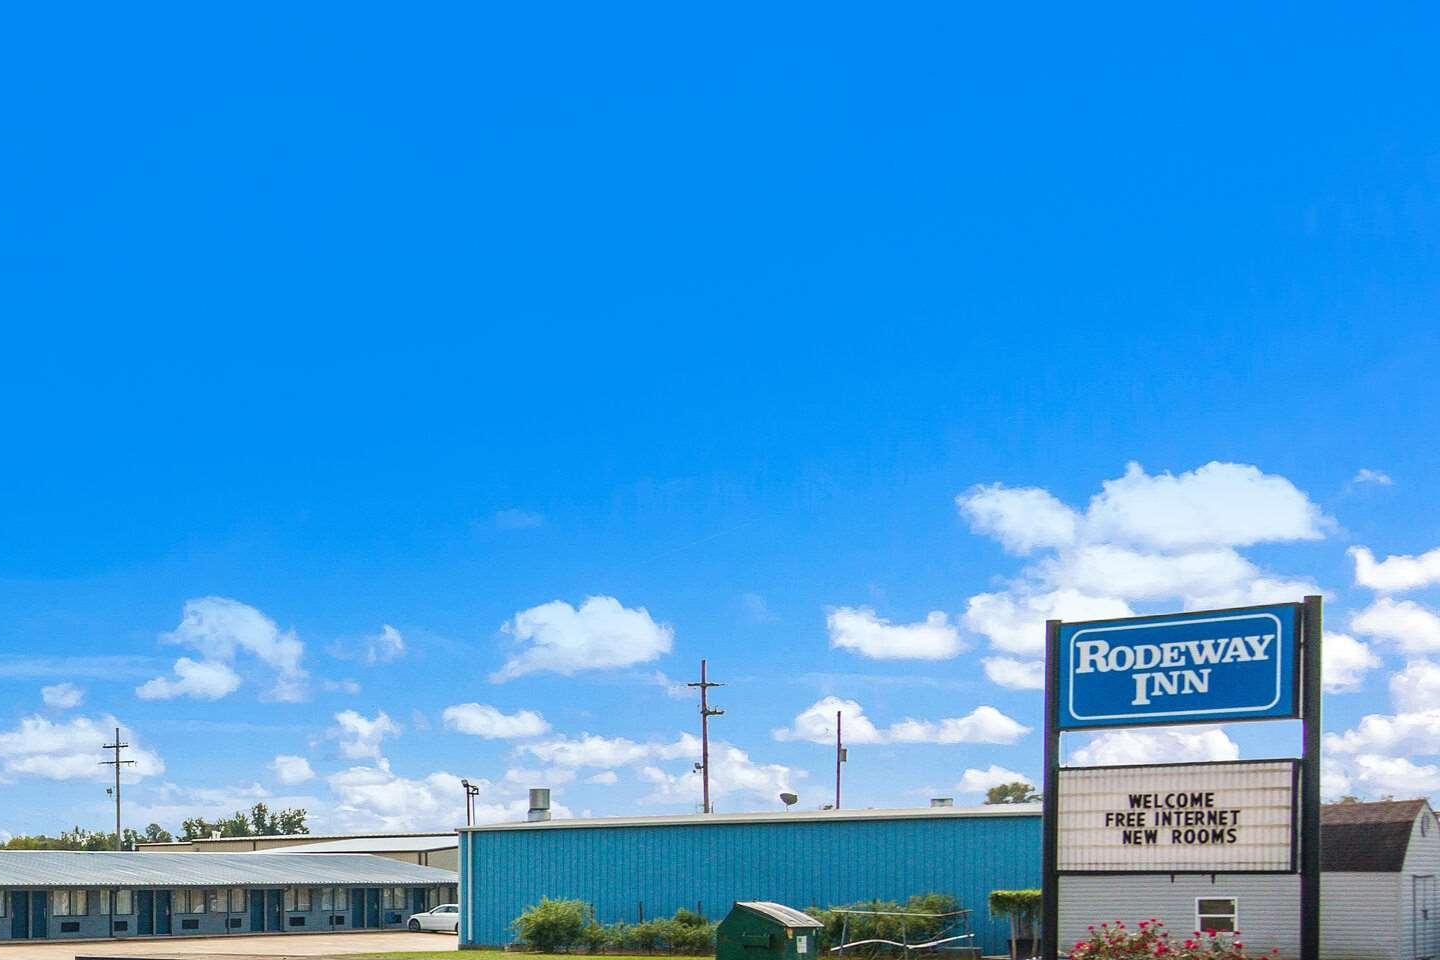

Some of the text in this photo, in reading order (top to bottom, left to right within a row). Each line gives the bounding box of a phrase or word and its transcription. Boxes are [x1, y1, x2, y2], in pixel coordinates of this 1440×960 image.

[1075, 634, 1275, 674] RODEWAY
[1131, 668, 1212, 706] INN
[1128, 792, 1215, 809] WELCOME
[1105, 810, 1241, 828] FREE INTERNET
[1122, 828, 1237, 845] NEW ROOMS
